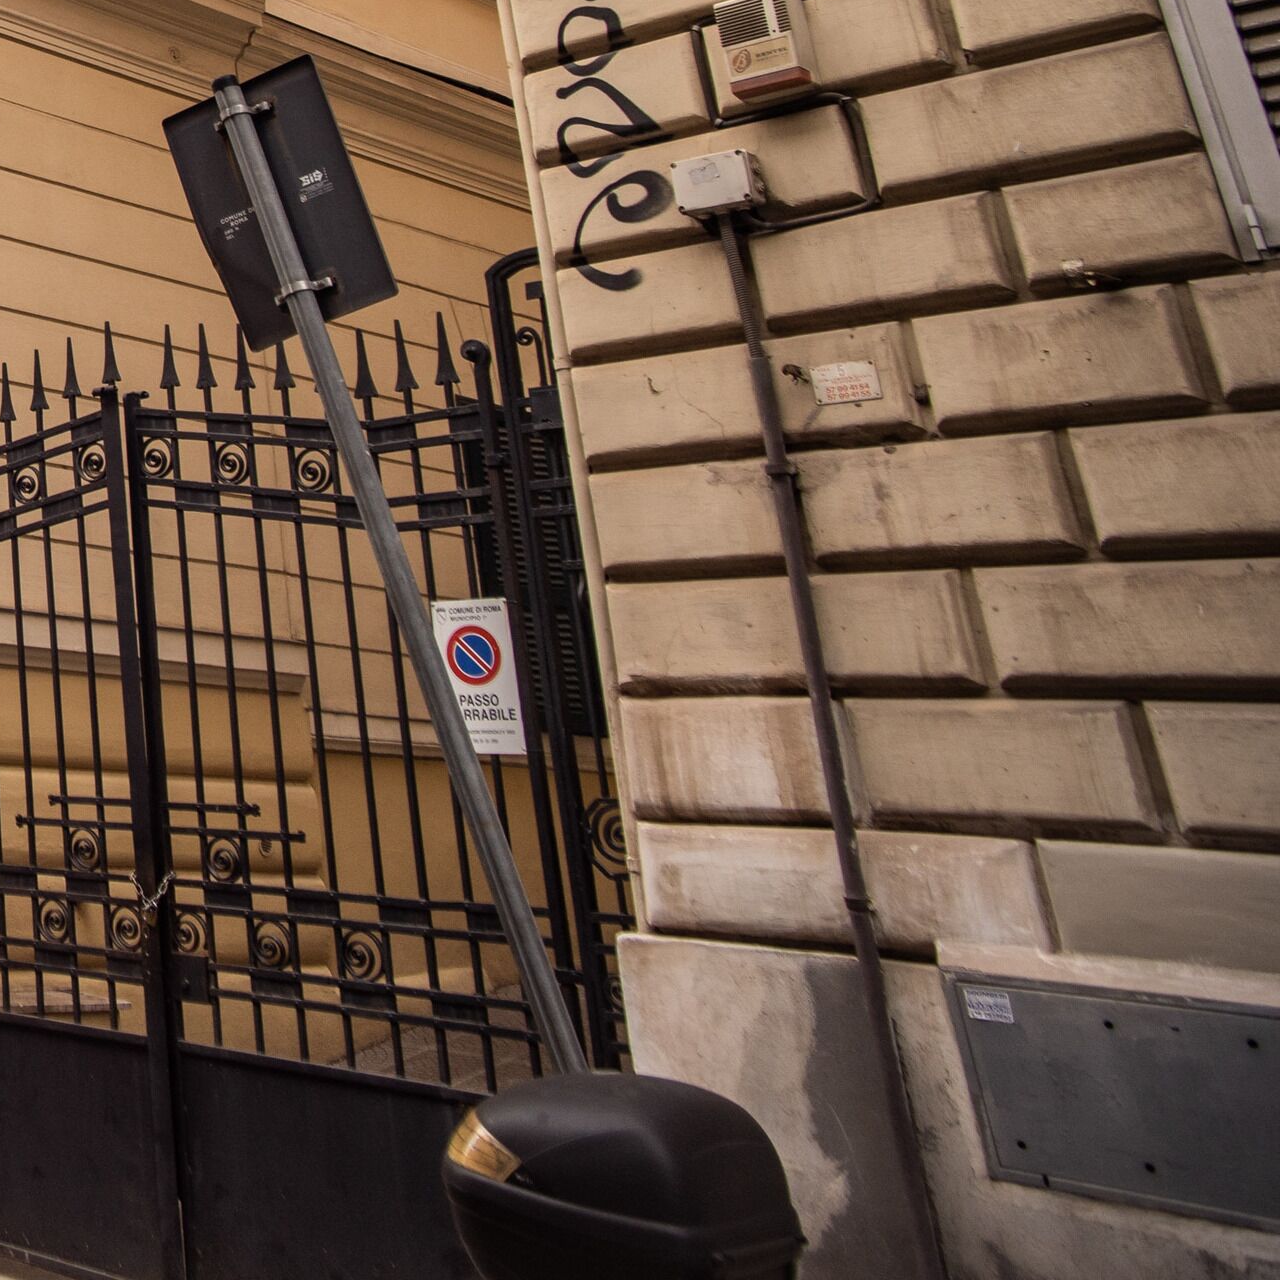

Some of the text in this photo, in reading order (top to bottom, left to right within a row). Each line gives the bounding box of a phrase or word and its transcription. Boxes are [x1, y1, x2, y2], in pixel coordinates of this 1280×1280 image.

[448, 606, 474, 615] COMUNE
[460, 694, 499, 706] PASSO
[464, 709, 517, 721] RRABILE
